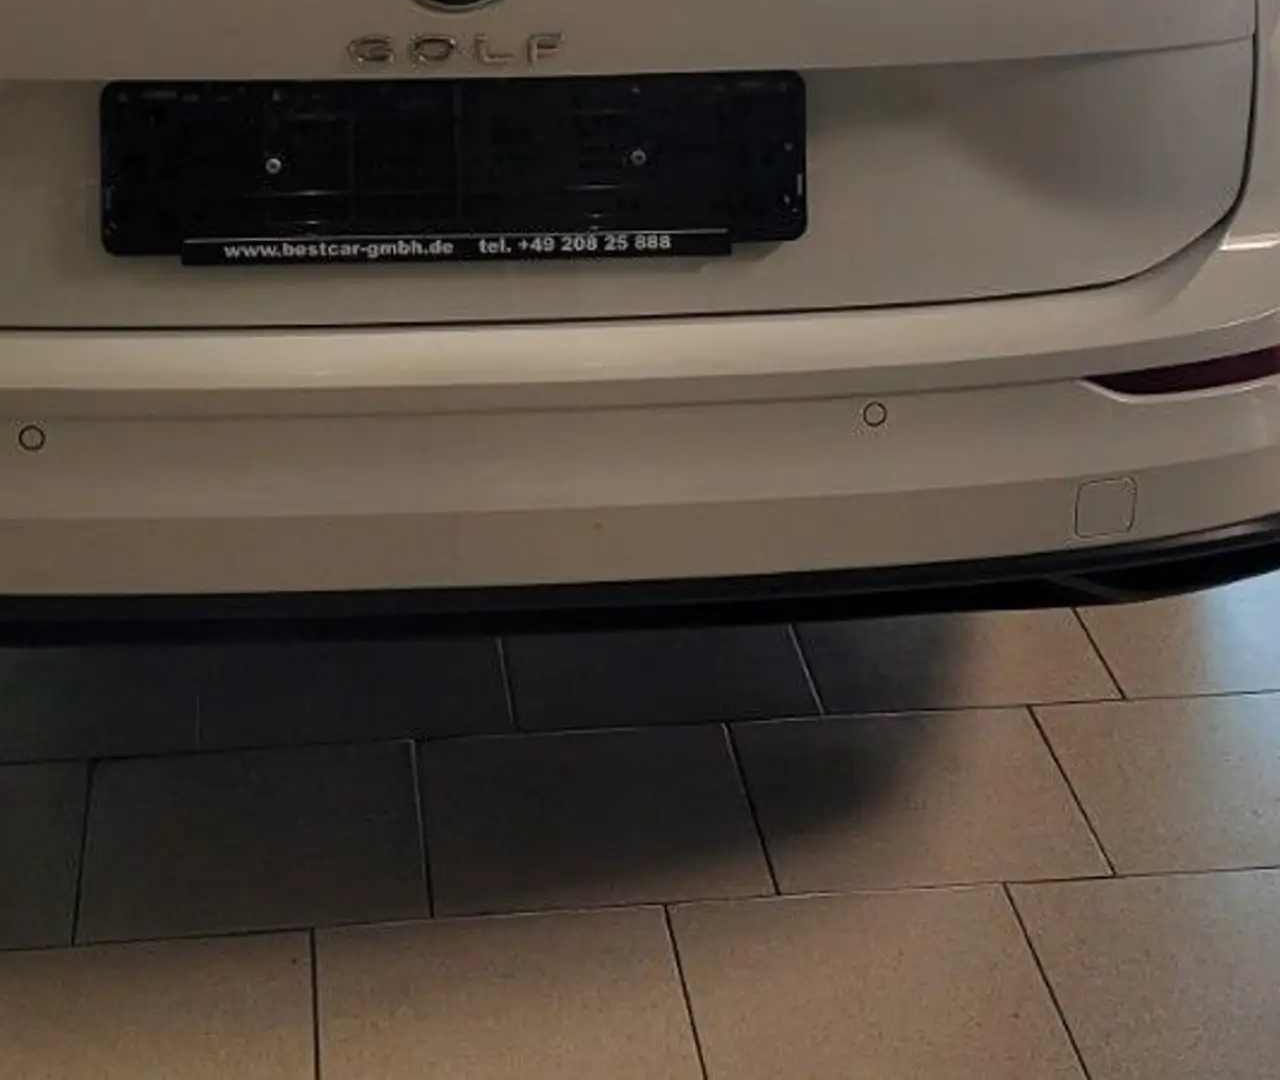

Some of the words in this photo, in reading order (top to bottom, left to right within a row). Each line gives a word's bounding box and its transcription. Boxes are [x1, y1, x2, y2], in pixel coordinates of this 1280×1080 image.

[346, 32, 565, 64] GOLF
[223, 239, 455, 259] www.bestcar-gmbh.de
[478, 237, 512, 254] tel.
[519, 236, 556, 252] +49
[560, 235, 599, 251] 208
[603, 234, 629, 251] 25
[634, 234, 671, 250] 888
